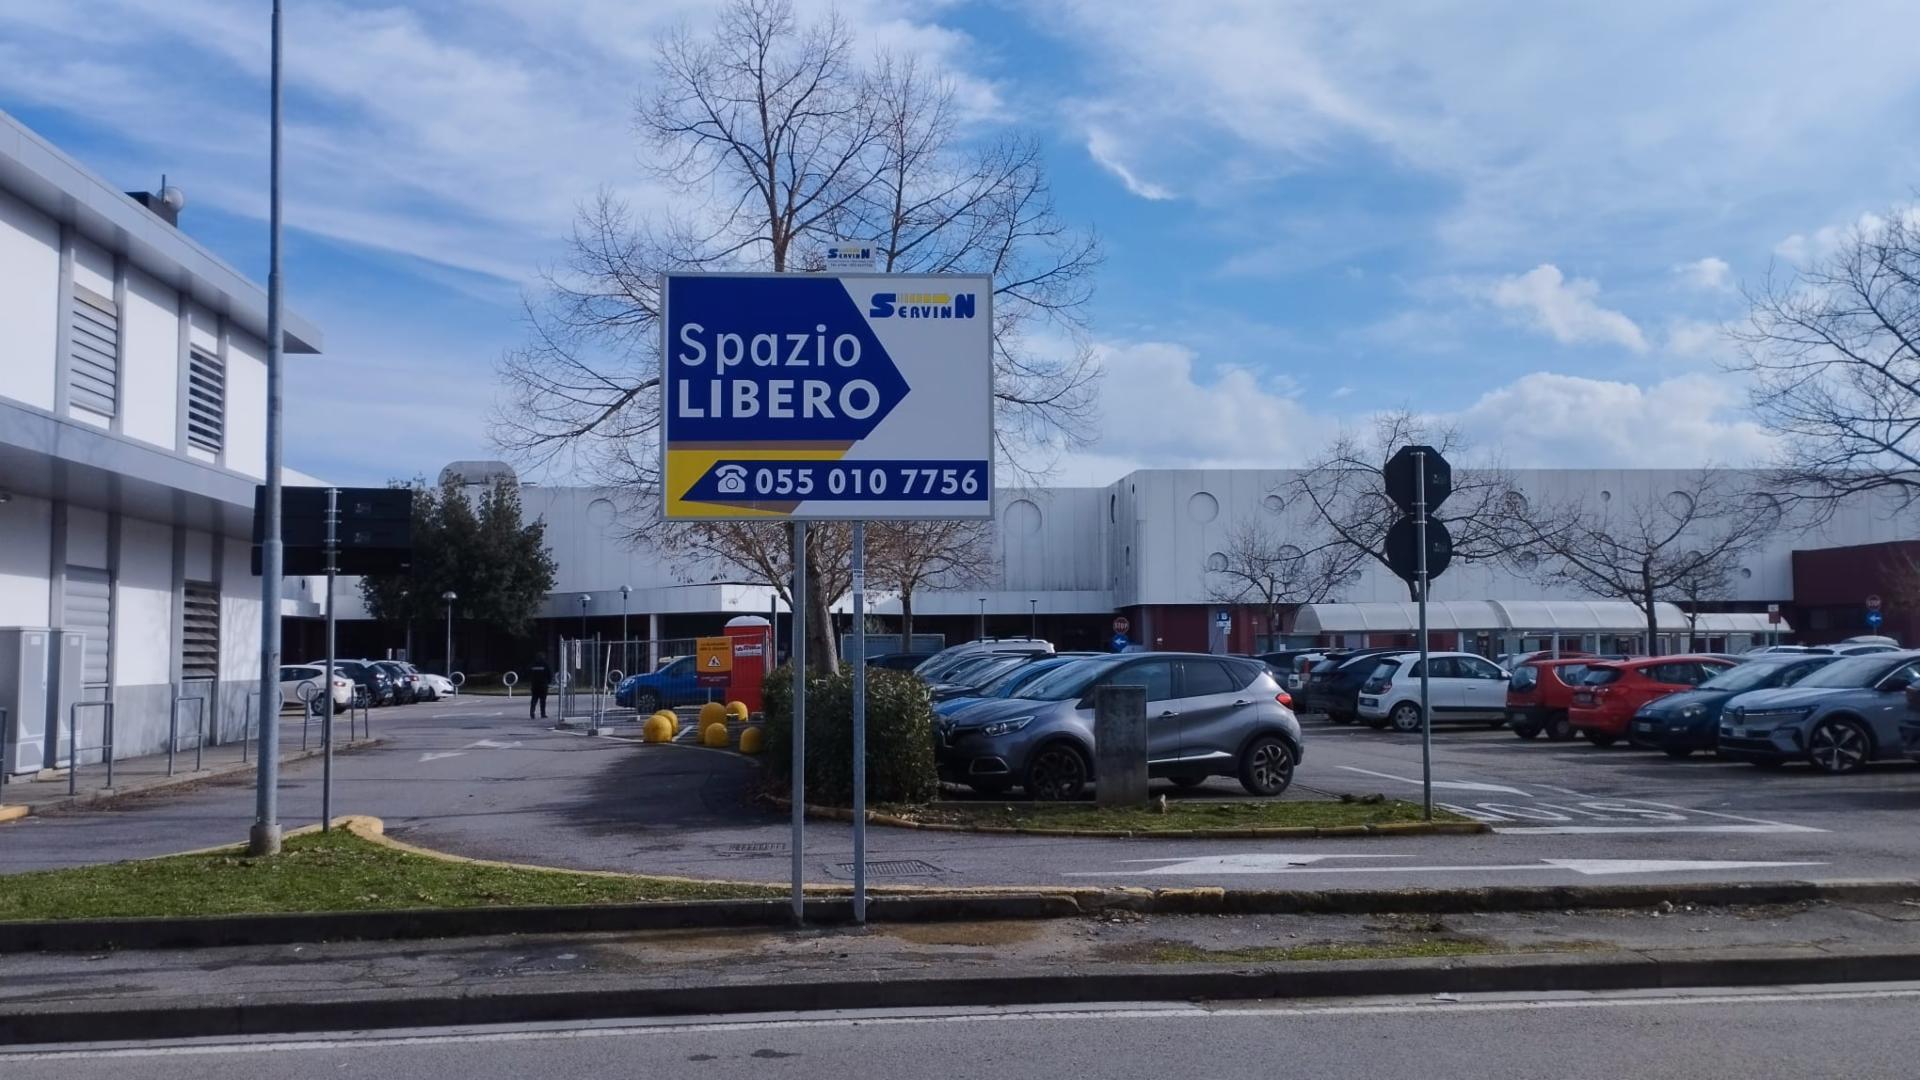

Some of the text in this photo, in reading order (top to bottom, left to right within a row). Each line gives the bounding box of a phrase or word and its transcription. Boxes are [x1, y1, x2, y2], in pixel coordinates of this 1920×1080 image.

[679, 322, 862, 375] Spazio
[679, 379, 880, 420] LIBERO
[755, 468, 978, 494] 055 010 7756
